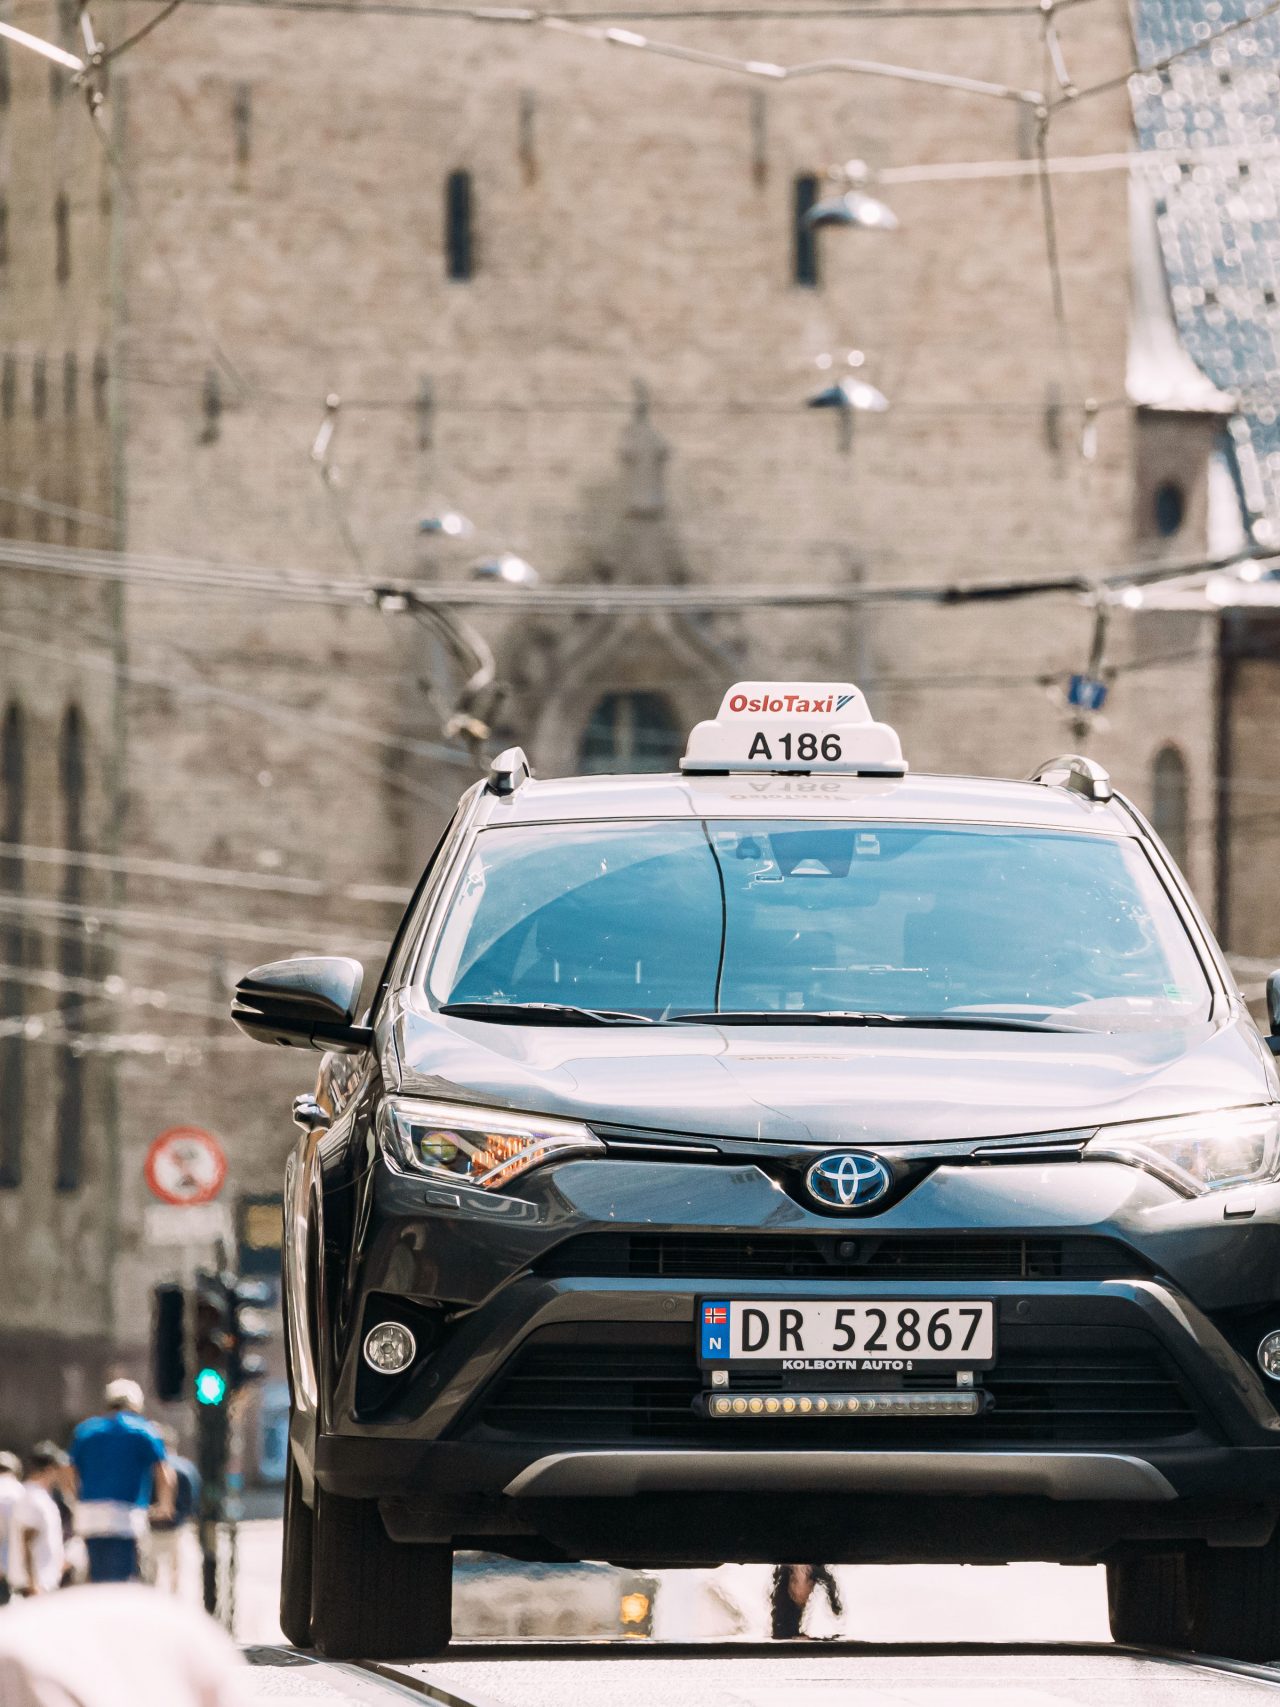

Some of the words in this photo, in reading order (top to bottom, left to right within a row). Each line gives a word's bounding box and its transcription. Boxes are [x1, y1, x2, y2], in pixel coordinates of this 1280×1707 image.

[729, 695, 834, 713] OsloTaxi
[741, 1308, 805, 1352] DR
[832, 1308, 983, 1352] 52867
[709, 1337, 722, 1350] N
[782, 1359, 857, 1371] KOLBOTN
[861, 1360, 904, 1371] AUTO
